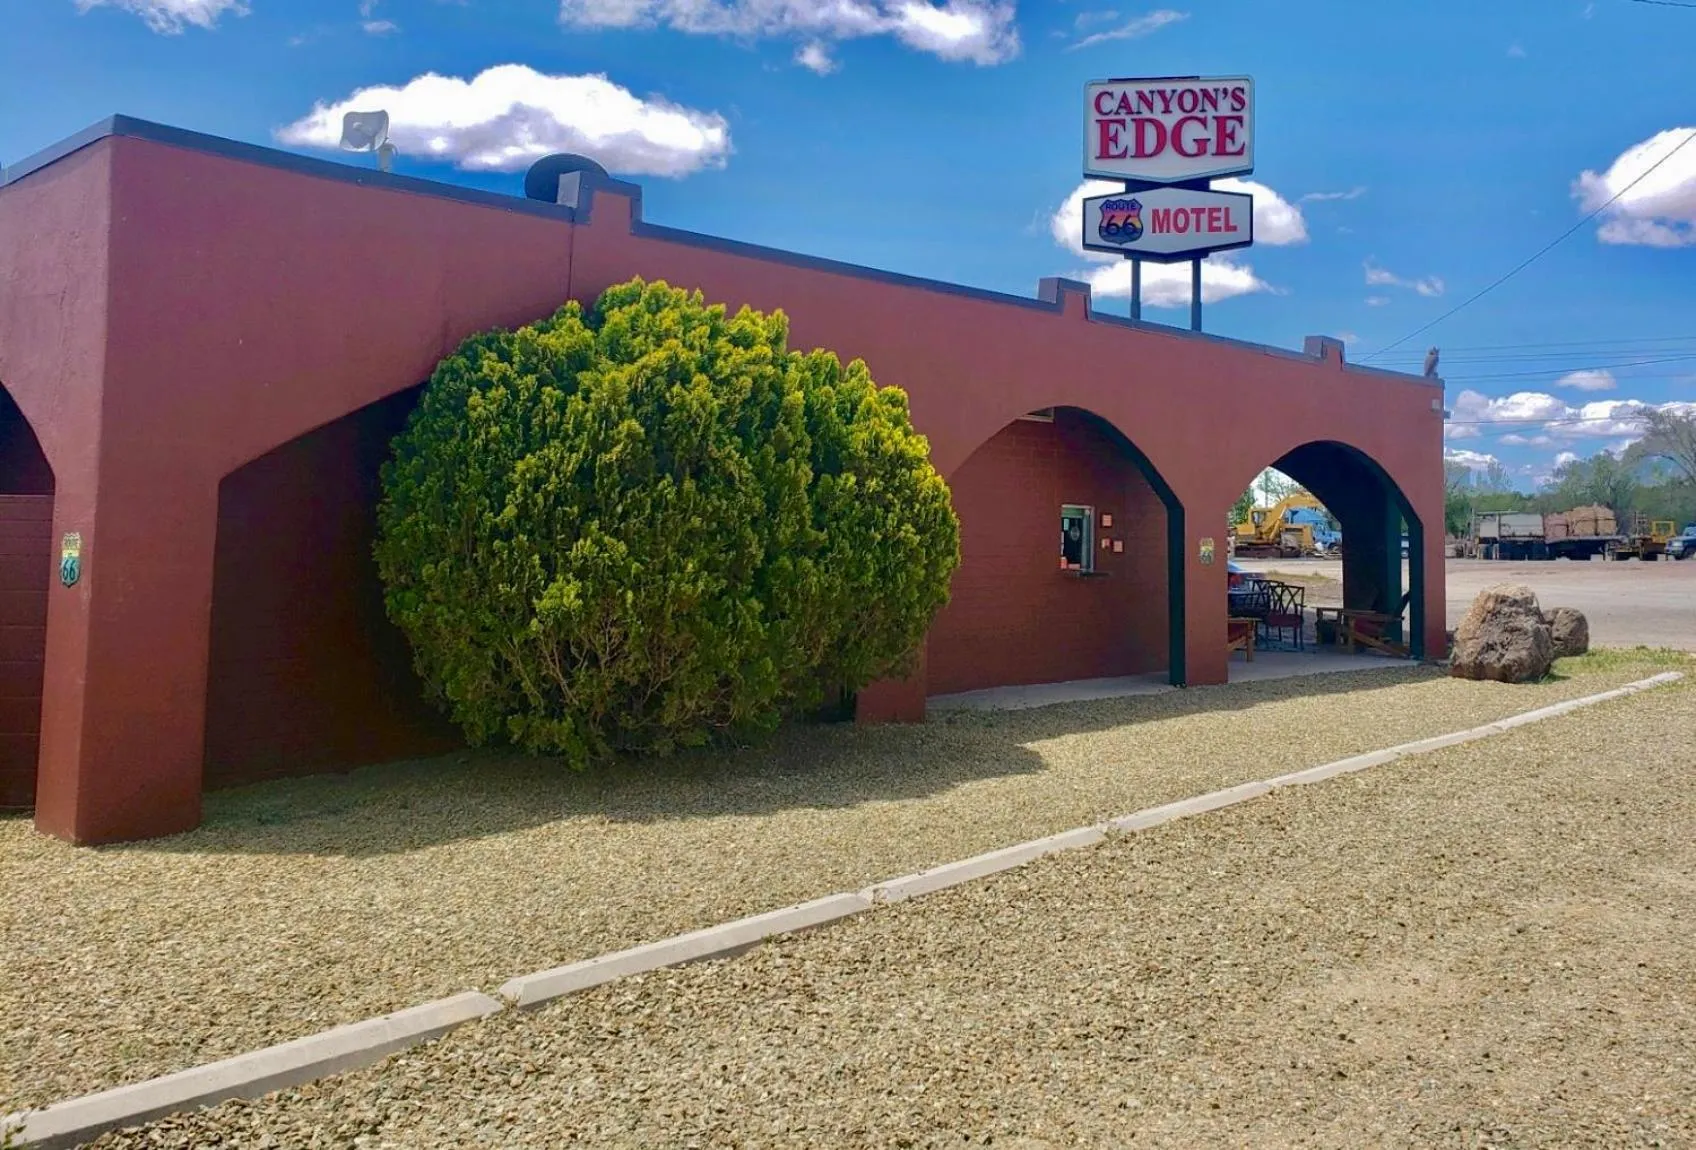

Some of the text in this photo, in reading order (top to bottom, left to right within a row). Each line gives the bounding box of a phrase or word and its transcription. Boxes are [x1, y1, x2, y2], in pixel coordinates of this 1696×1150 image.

[1094, 86, 1246, 116] CANYON'S
[1095, 115, 1246, 160] EDGE
[1105, 202, 1137, 212] ROUTE
[1105, 214, 1138, 236] 66
[1151, 206, 1238, 234] MOTEL
[62, 559, 76, 581] 66
